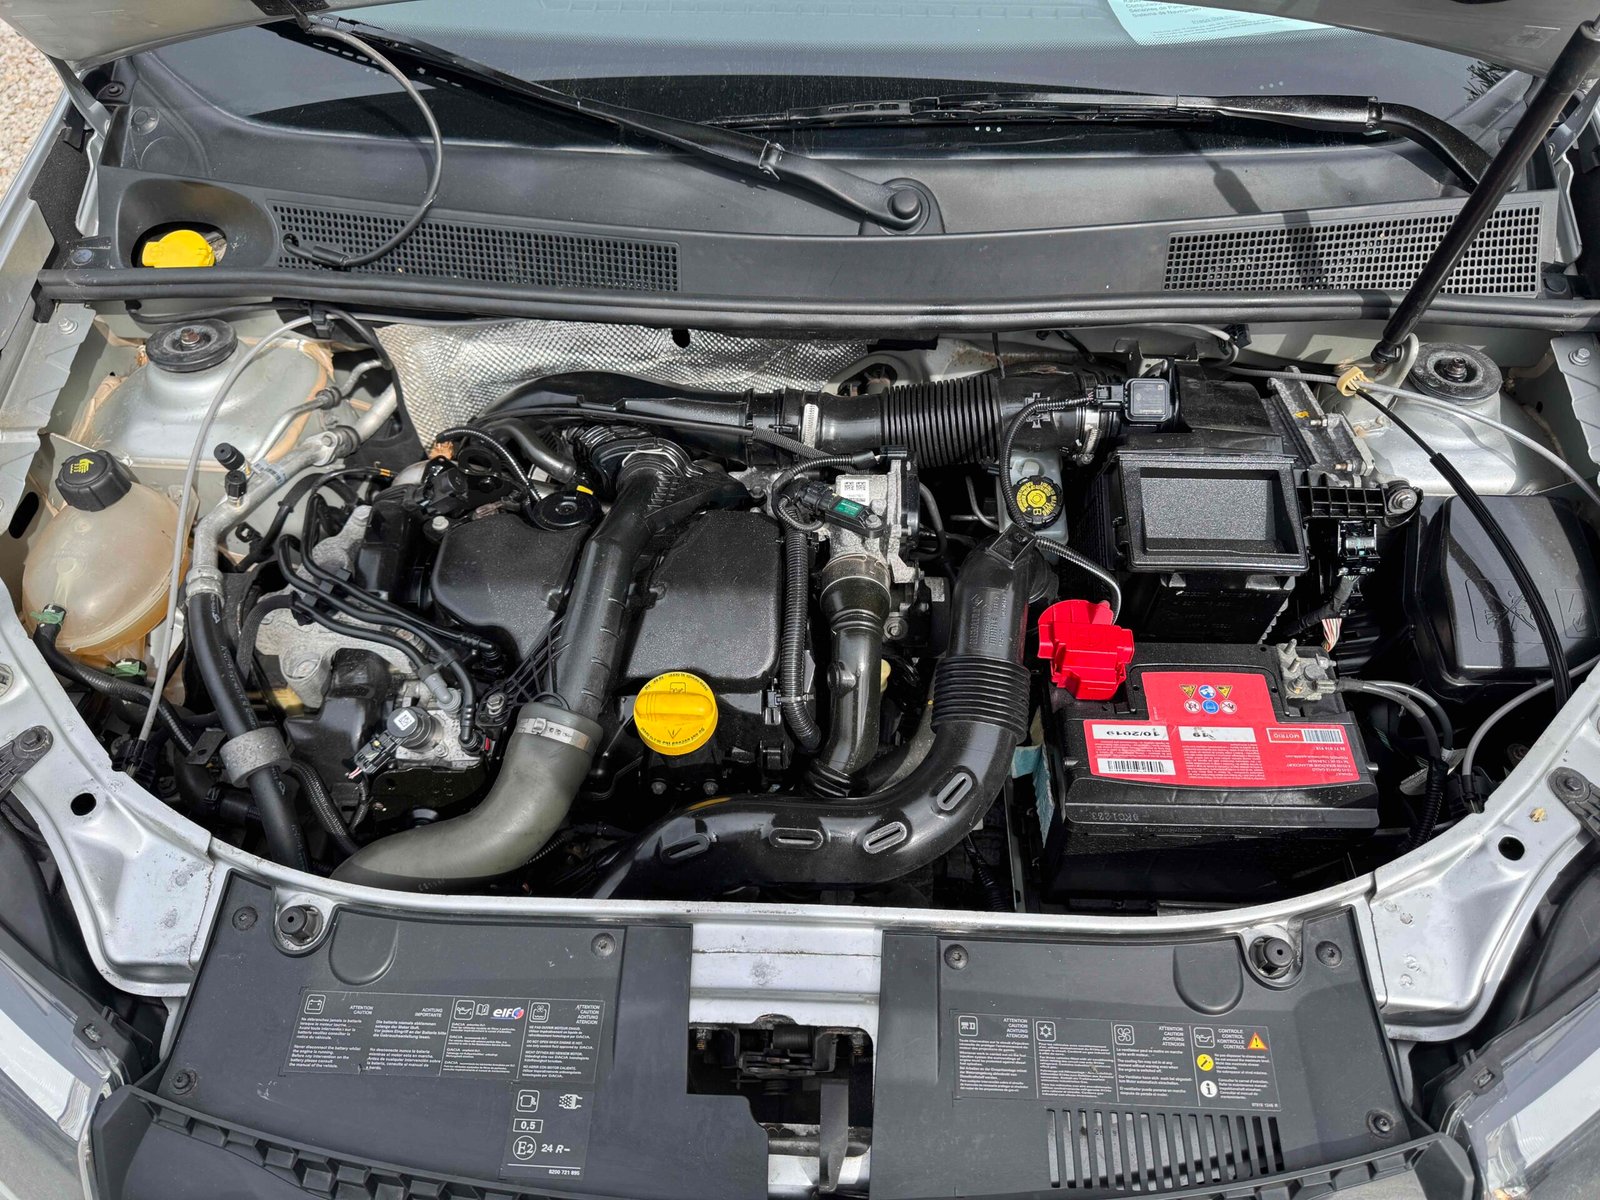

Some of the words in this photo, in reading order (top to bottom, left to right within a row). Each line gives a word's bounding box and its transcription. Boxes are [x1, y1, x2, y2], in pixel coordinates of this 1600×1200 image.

[493, 1008, 513, 1017] elf
[520, 1121, 536, 1130] 0,5
[516, 1141, 534, 1155] E2
[541, 1144, 553, 1152] 24
